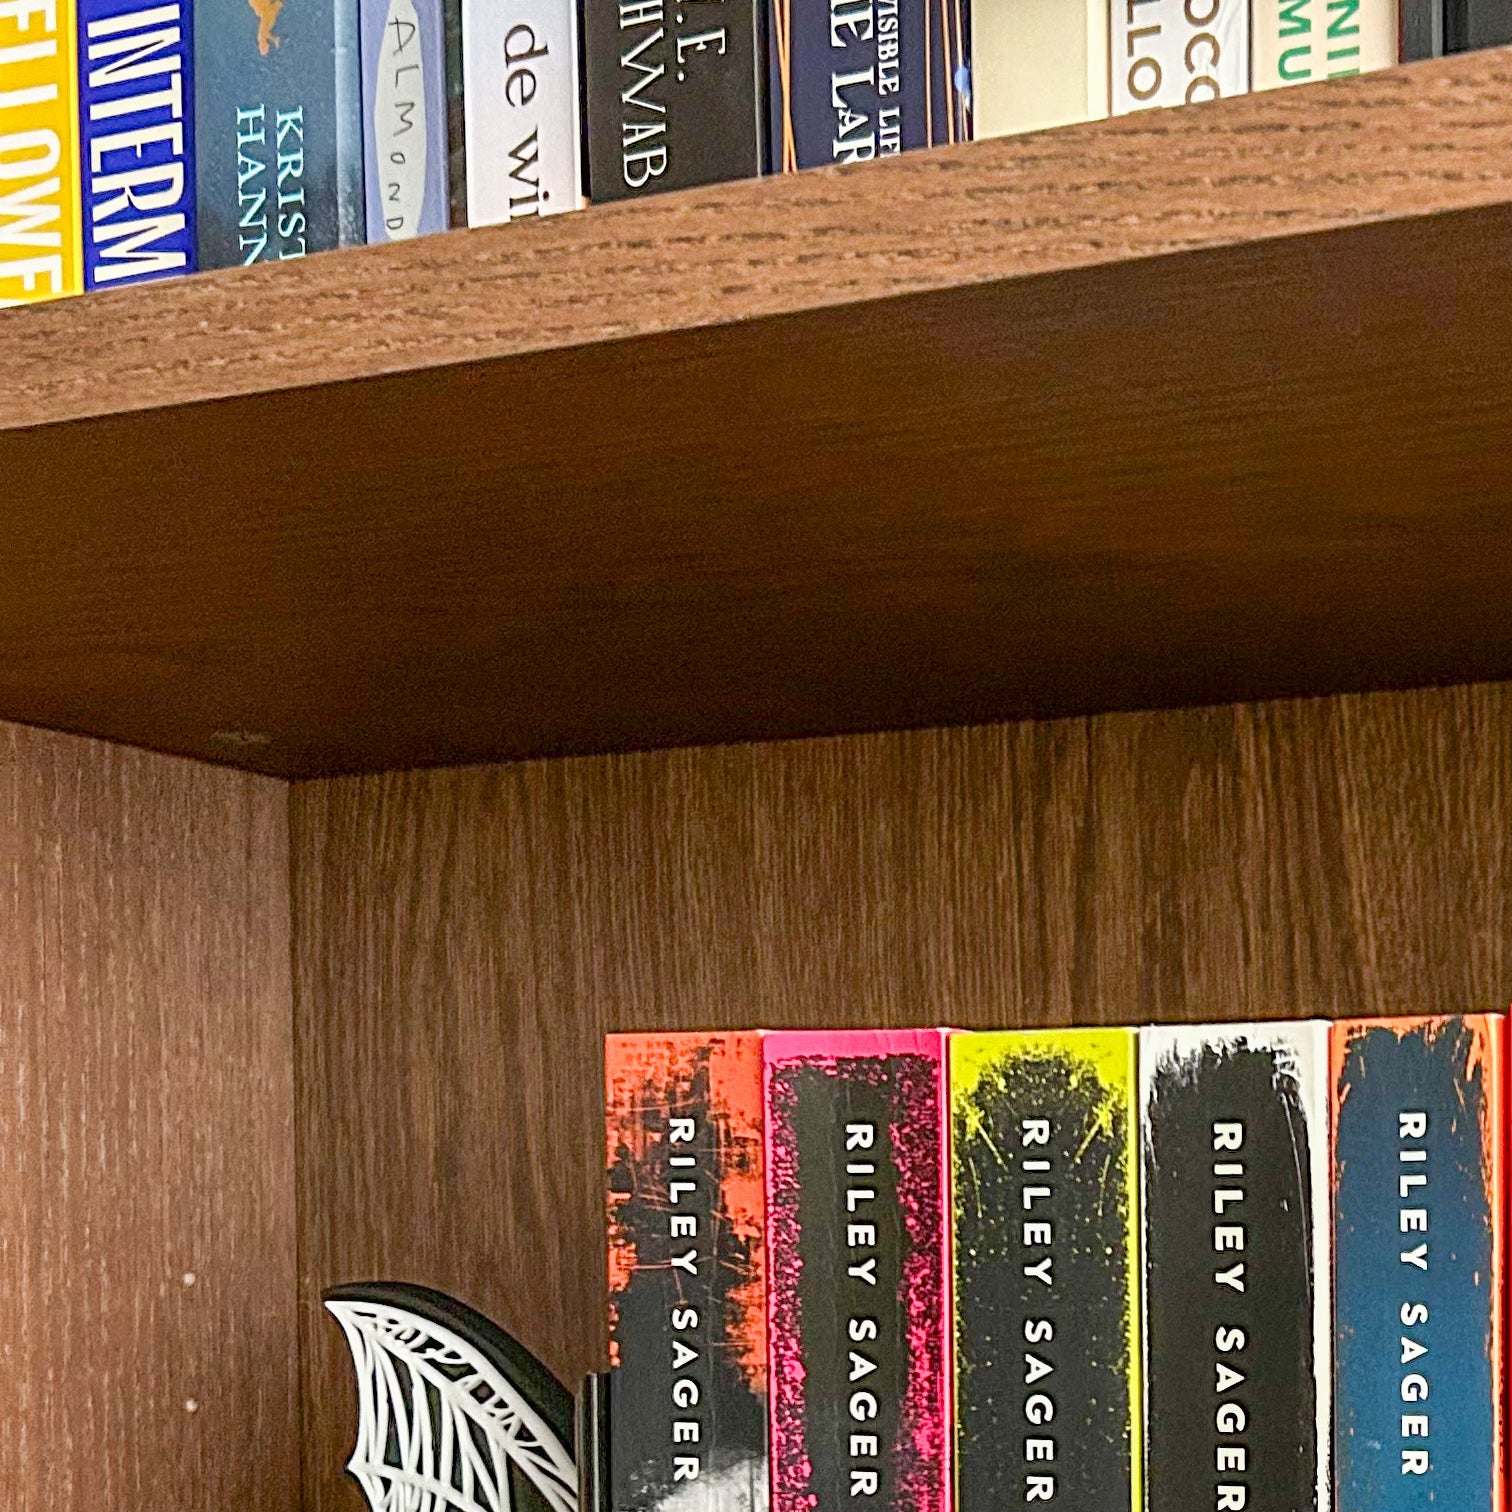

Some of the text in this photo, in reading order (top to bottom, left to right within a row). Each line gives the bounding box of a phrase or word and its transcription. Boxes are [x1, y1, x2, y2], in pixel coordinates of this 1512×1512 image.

[87, 3, 187, 283] INTERM
[386, 16, 419, 231] ALMOND
[504, 24, 548, 107] de
[619, 0, 667, 188] HWAB
[669, 1117, 700, 1482] RILEY SAGER
[846, 1123, 878, 1497] RILEY SAGER
[1022, 1118, 1054, 1503] RILEY SAGER
[1213, 1122, 1246, 1512] RILEY SAGER
[1399, 1112, 1429, 1476] RILEY SAGER
